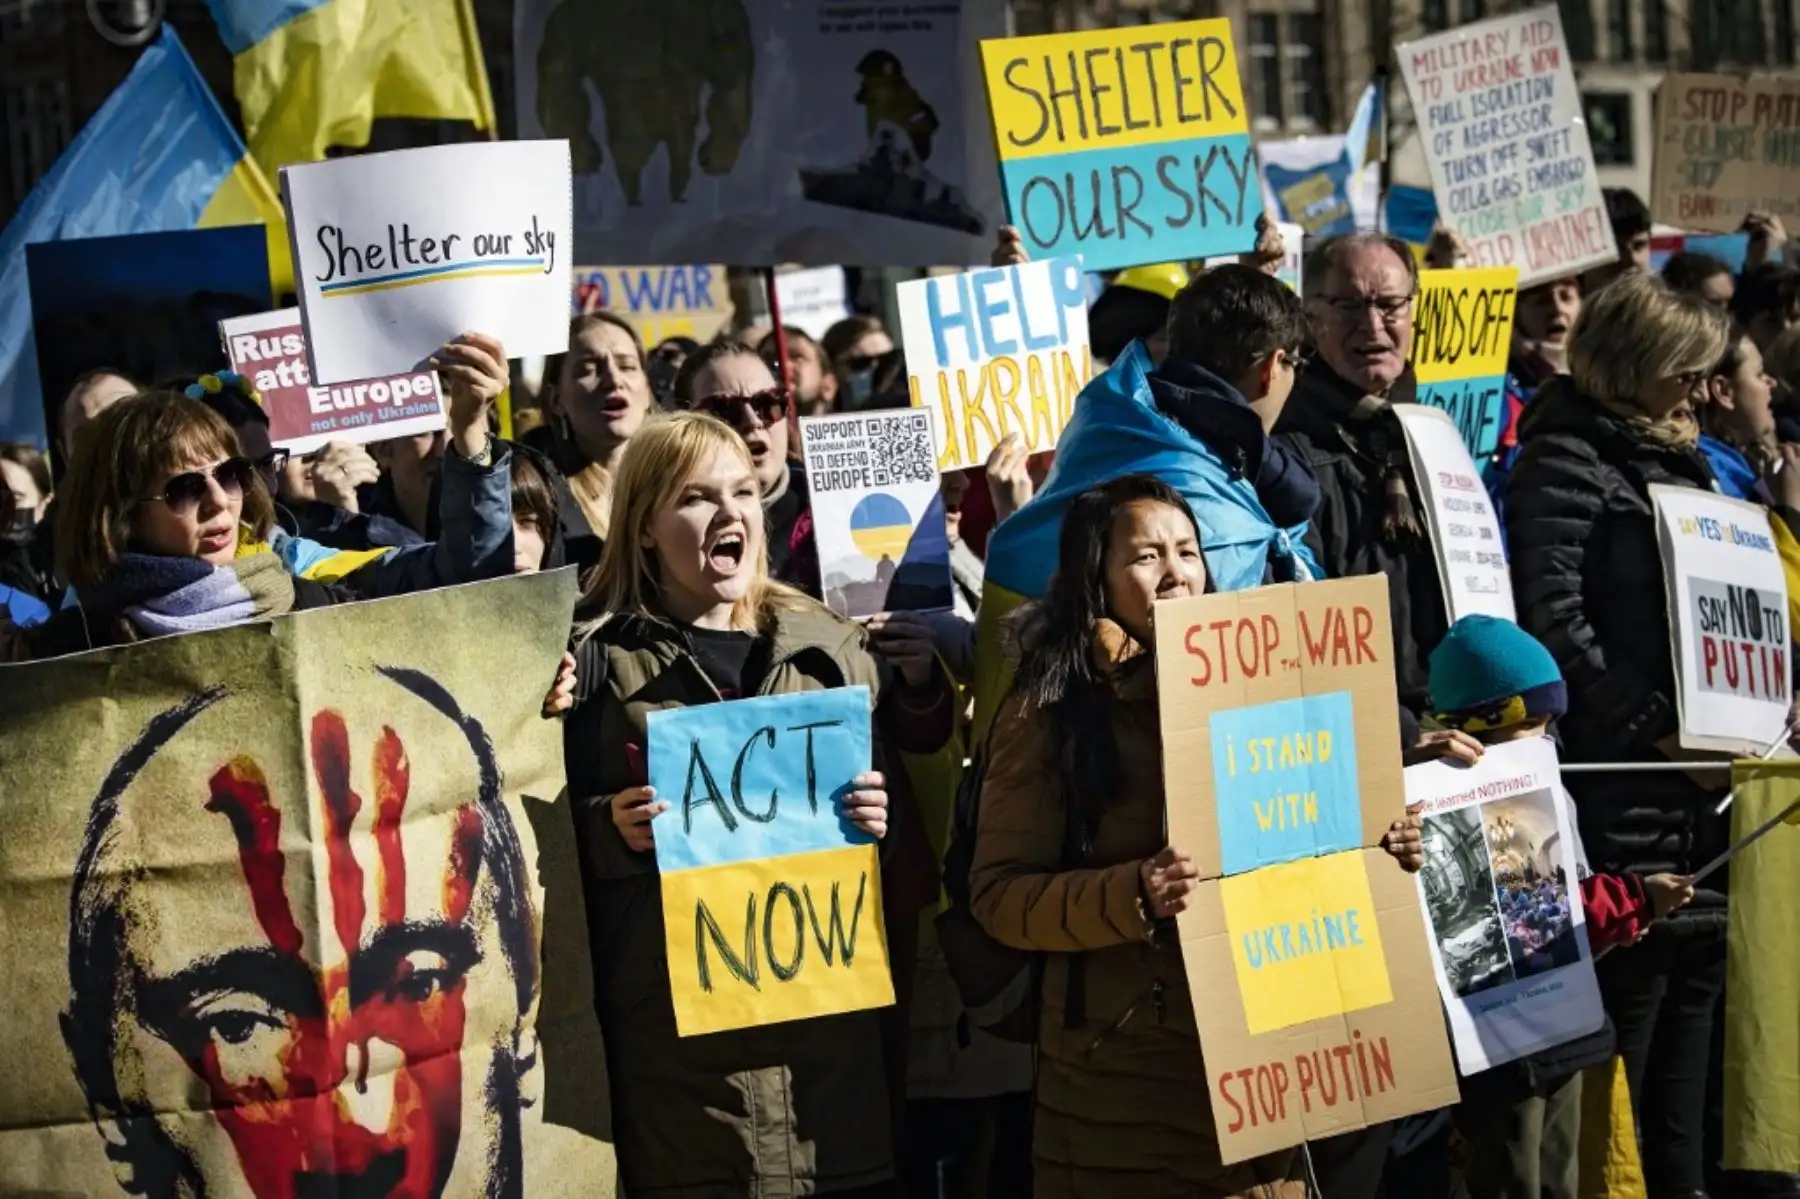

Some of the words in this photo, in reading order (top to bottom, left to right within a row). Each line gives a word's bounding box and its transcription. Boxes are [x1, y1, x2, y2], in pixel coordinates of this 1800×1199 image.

[1411, 28, 1510, 77] MILITARY
[1519, 20, 1554, 48] AID
[1004, 36, 1237, 147] SHELTER
[1418, 76, 1443, 103] TO
[1453, 53, 1525, 94] UKRAINE
[1429, 101, 1465, 130] FULL
[1470, 76, 1555, 117] ISOLATION
[1433, 131, 1453, 158] OF
[1463, 103, 1554, 148] AGGRESSOR
[1683, 88, 1747, 123] STOP
[1441, 153, 1488, 187] TURN
[1490, 141, 1518, 173] OFF
[1525, 128, 1571, 163] SWIFT
[1492, 172, 1523, 200] GAS
[1526, 157, 1587, 194] EMBARGO
[1021, 165, 1154, 249] OUR
[1156, 145, 1257, 228] SKY
[316, 223, 461, 282] Shelter
[474, 233, 513, 256] our
[524, 215, 555, 275] sky
[620, 264, 714, 313] WAR
[926, 255, 1085, 367] HELP
[229, 333, 305, 364] Rus
[1469, 287, 1515, 357] OFF
[307, 374, 434, 414] Europe
[311, 419, 336, 432] not
[342, 412, 374, 427] only
[378, 401, 439, 420] Ukraine
[805, 419, 863, 441] SUPPORT
[846, 439, 867, 450] ARMY
[810, 455, 825, 470] TO
[827, 451, 869, 468] DEFEND
[812, 468, 873, 492] EUROPE
[1695, 516, 1722, 542] YES
[1698, 594, 1727, 637] SAY
[1727, 584, 1763, 641] NO
[1762, 608, 1785, 645] TO
[1184, 614, 1280, 687] STOP
[1298, 606, 1378, 668] WAR
[1702, 635, 1787, 700] PUTIN
[683, 719, 843, 836] ACT
[1247, 730, 1333, 775] STAND
[1435, 790, 1476, 809] learned
[1477, 773, 1534, 799] NOTHING
[695, 871, 867, 993] NOW
[1218, 1061, 1289, 1134] STOP
